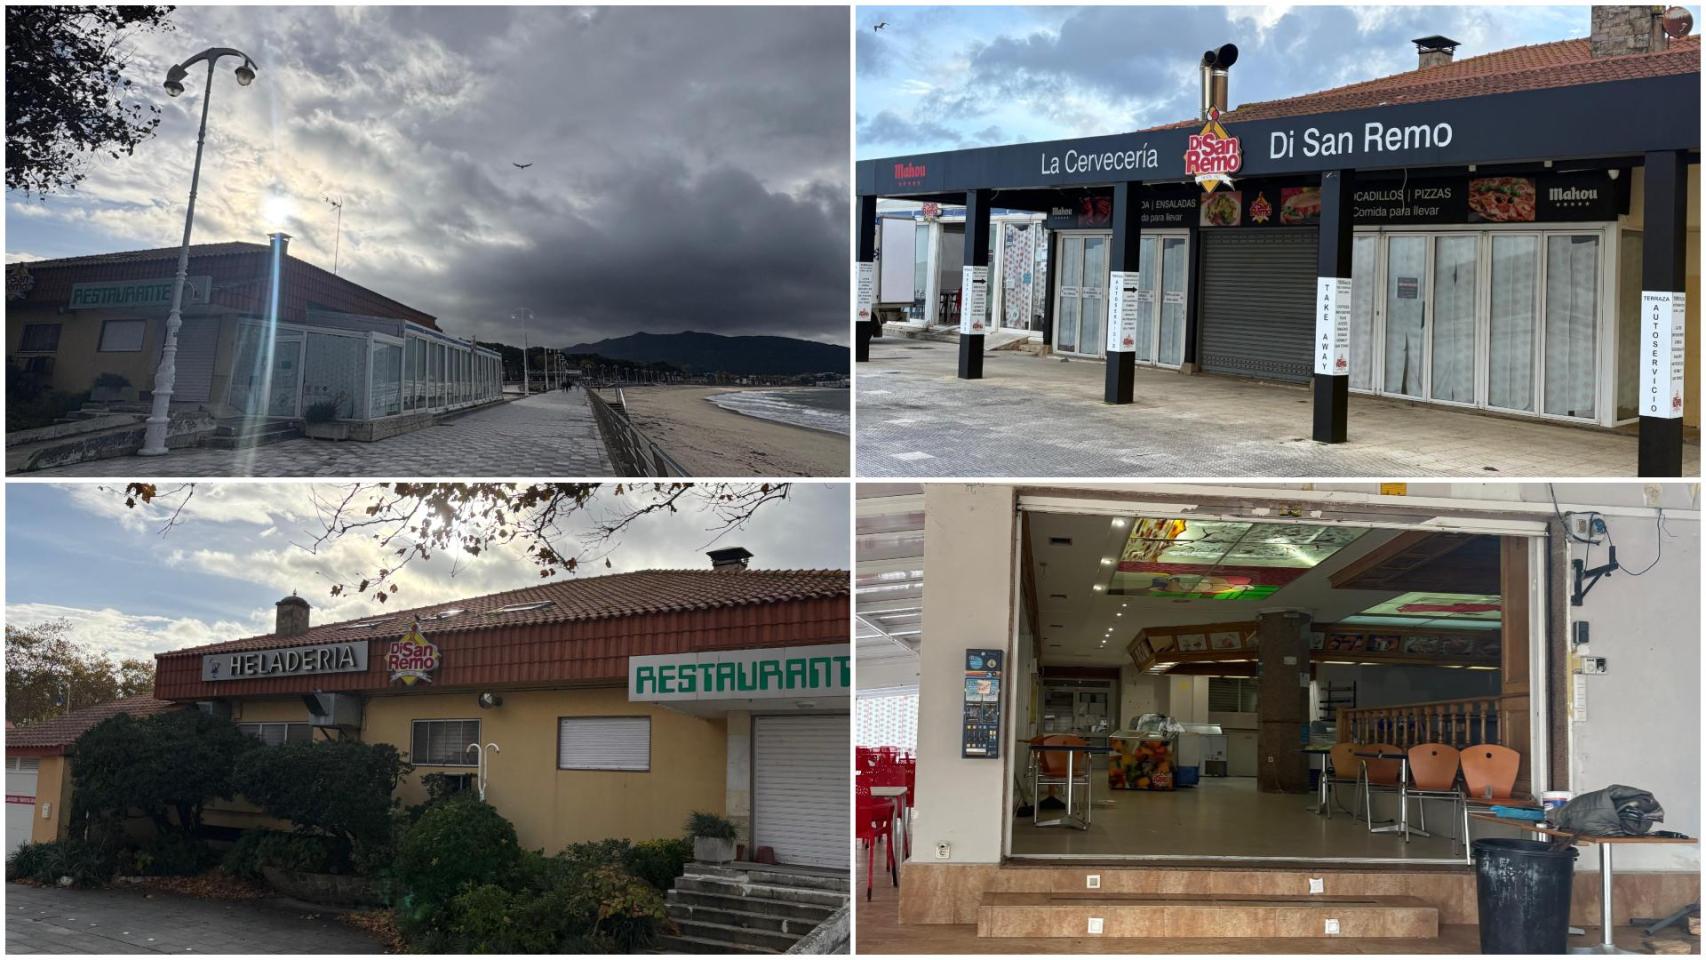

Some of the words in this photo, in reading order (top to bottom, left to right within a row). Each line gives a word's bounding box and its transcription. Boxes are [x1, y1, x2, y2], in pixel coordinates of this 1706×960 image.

[1270, 131, 1294, 159] Di
[1303, 127, 1353, 157] San
[1364, 122, 1453, 153] Remo
[1041, 153, 1059, 175] La
[1065, 143, 1158, 173] Cervecería
[1186, 150, 1239, 172] Remo
[894, 162, 926, 179] Mahou
[1155, 199, 1196, 209] ENSALADAS
[1414, 187, 1452, 199] PIZZAS
[1549, 186, 1598, 201] Mahou
[1389, 207, 1411, 219] para
[1412, 205, 1440, 216] llevar
[74, 283, 172, 305] RESTAURANTE
[1321, 333, 1329, 370] AWAY
[1651, 304, 1660, 412] AUTOSERVICIO
[229, 645, 356, 676] HELADERIA
[388, 655, 434, 669] Remo
